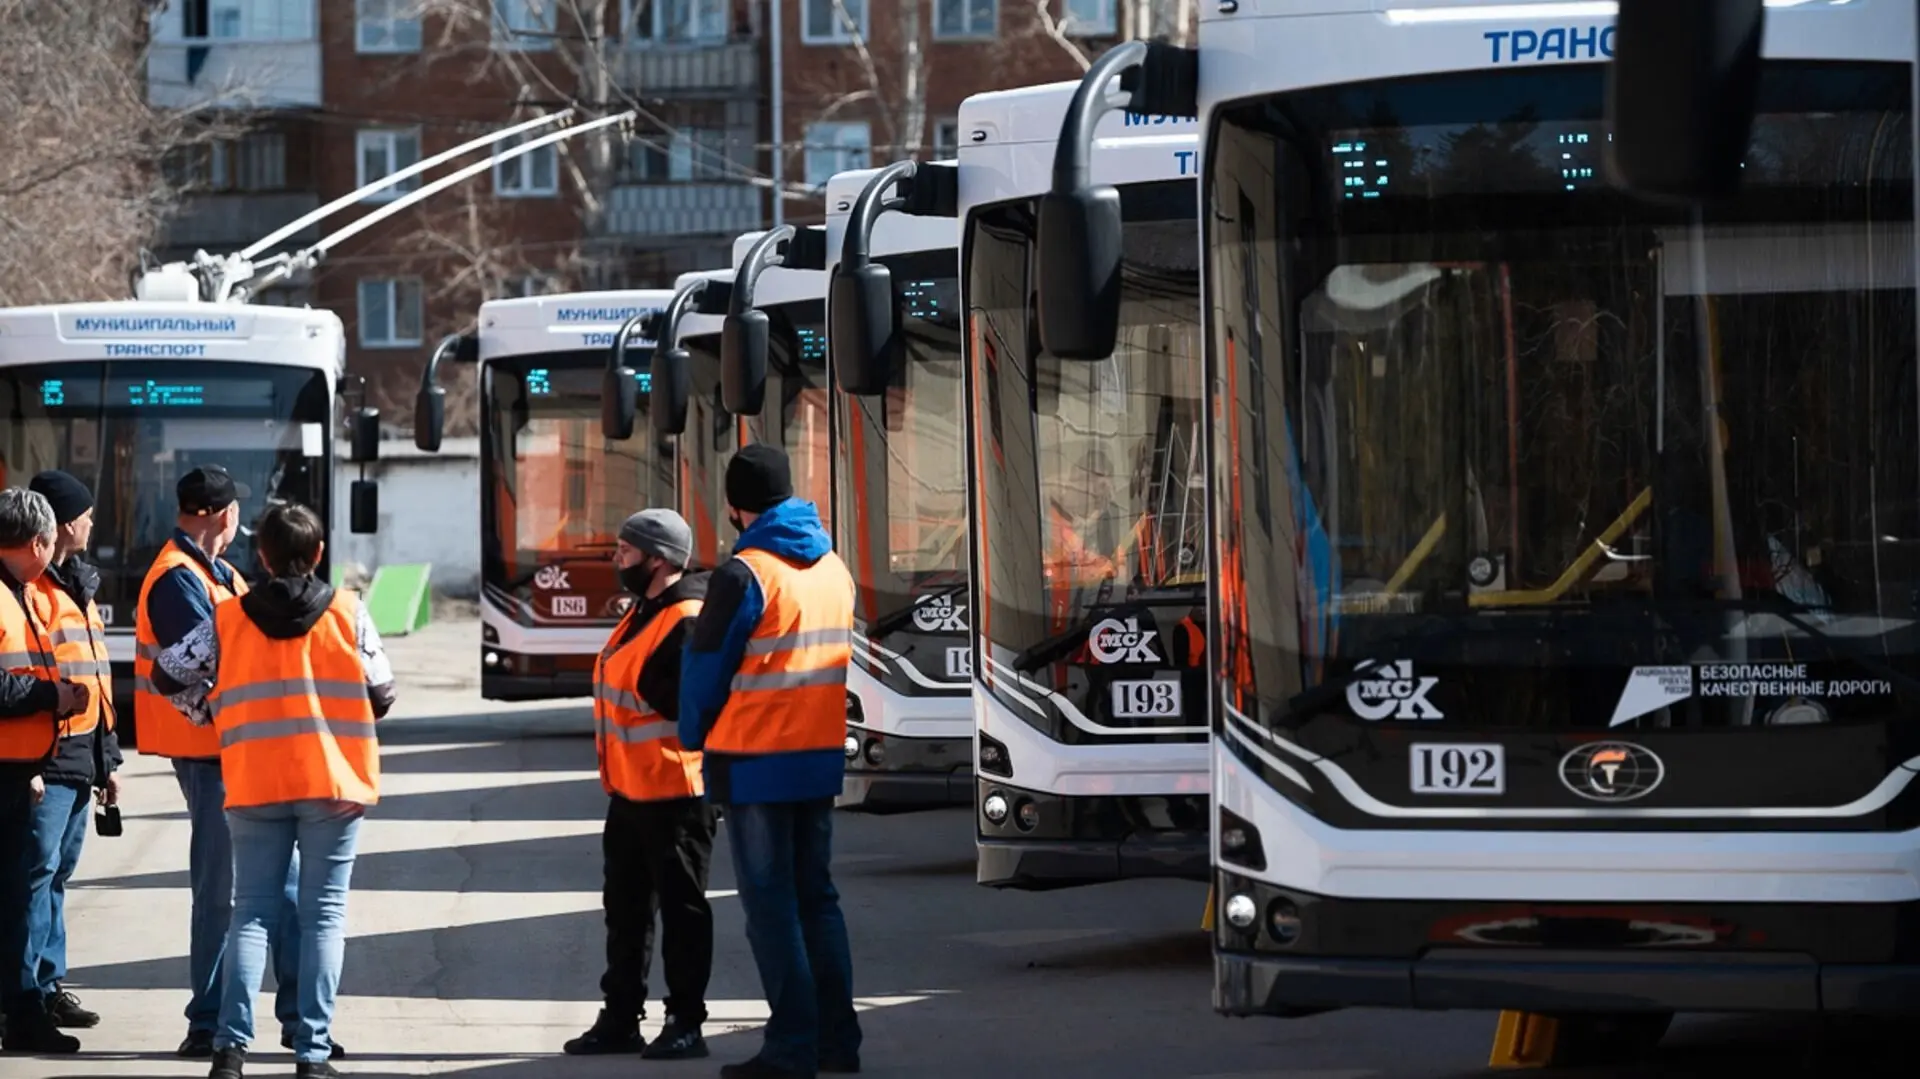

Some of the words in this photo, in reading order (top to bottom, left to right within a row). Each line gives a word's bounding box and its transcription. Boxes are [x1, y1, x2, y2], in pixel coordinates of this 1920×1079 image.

[75, 316, 236, 332] МУНИЦИПАЛЬНЫЙ
[104, 344, 206, 356] ТРАНСПОРТ
[556, 599, 583, 613] 186
[1700, 665, 1807, 679] БЕЗОПАСНЫЕ
[1700, 681, 1825, 696] КАЧЕСТВЕННЫЕ
[1827, 680, 1891, 697] ДОРОГИ
[1118, 683, 1175, 713] 193
[1418, 748, 1497, 788] 192
